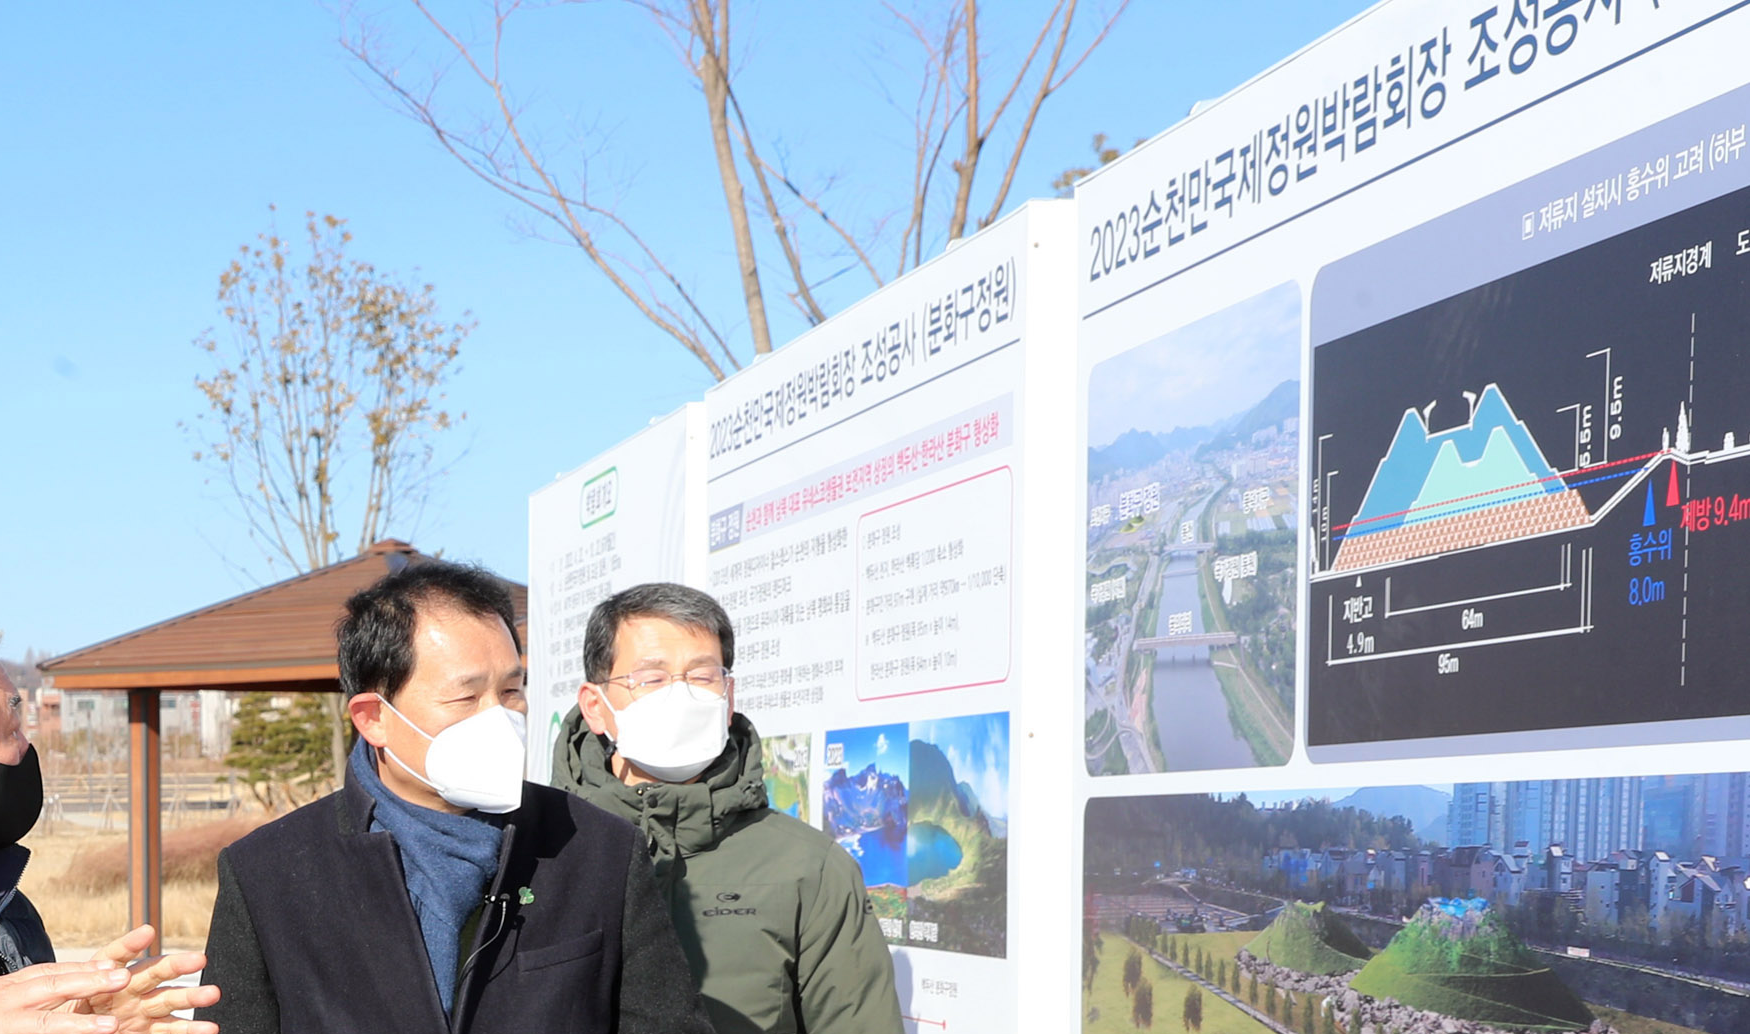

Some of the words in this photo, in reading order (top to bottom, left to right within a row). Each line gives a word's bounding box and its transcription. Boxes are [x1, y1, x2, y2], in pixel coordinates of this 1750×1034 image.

[1090, 27, 1451, 283] 2023순천만국제정원박람회장
[1539, 191, 1578, 232] 저류지
[1581, 174, 1622, 219] 설치시
[1625, 154, 1669, 201] 홍수위
[1673, 140, 1704, 180] 고려
[1709, 124, 1746, 170] (하부
[1649, 241, 1712, 284] 저류지경계
[710, 344, 855, 459] 2023순천만국제정원박람회장
[860, 312, 916, 386] 조성공사
[922, 256, 1016, 362] (분화구정원)
[1610, 376, 1623, 440] 9.5m
[1579, 405, 1592, 467] 5.5m
[1680, 496, 1712, 532] 제방
[1628, 528, 1672, 567] 홍수위
[1343, 596, 1373, 623] 지반고
[1628, 576, 1665, 605] 8.0m
[1462, 608, 1483, 630] 64m
[1346, 632, 1374, 654] 4.9m
[1438, 653, 1459, 674] 95m
